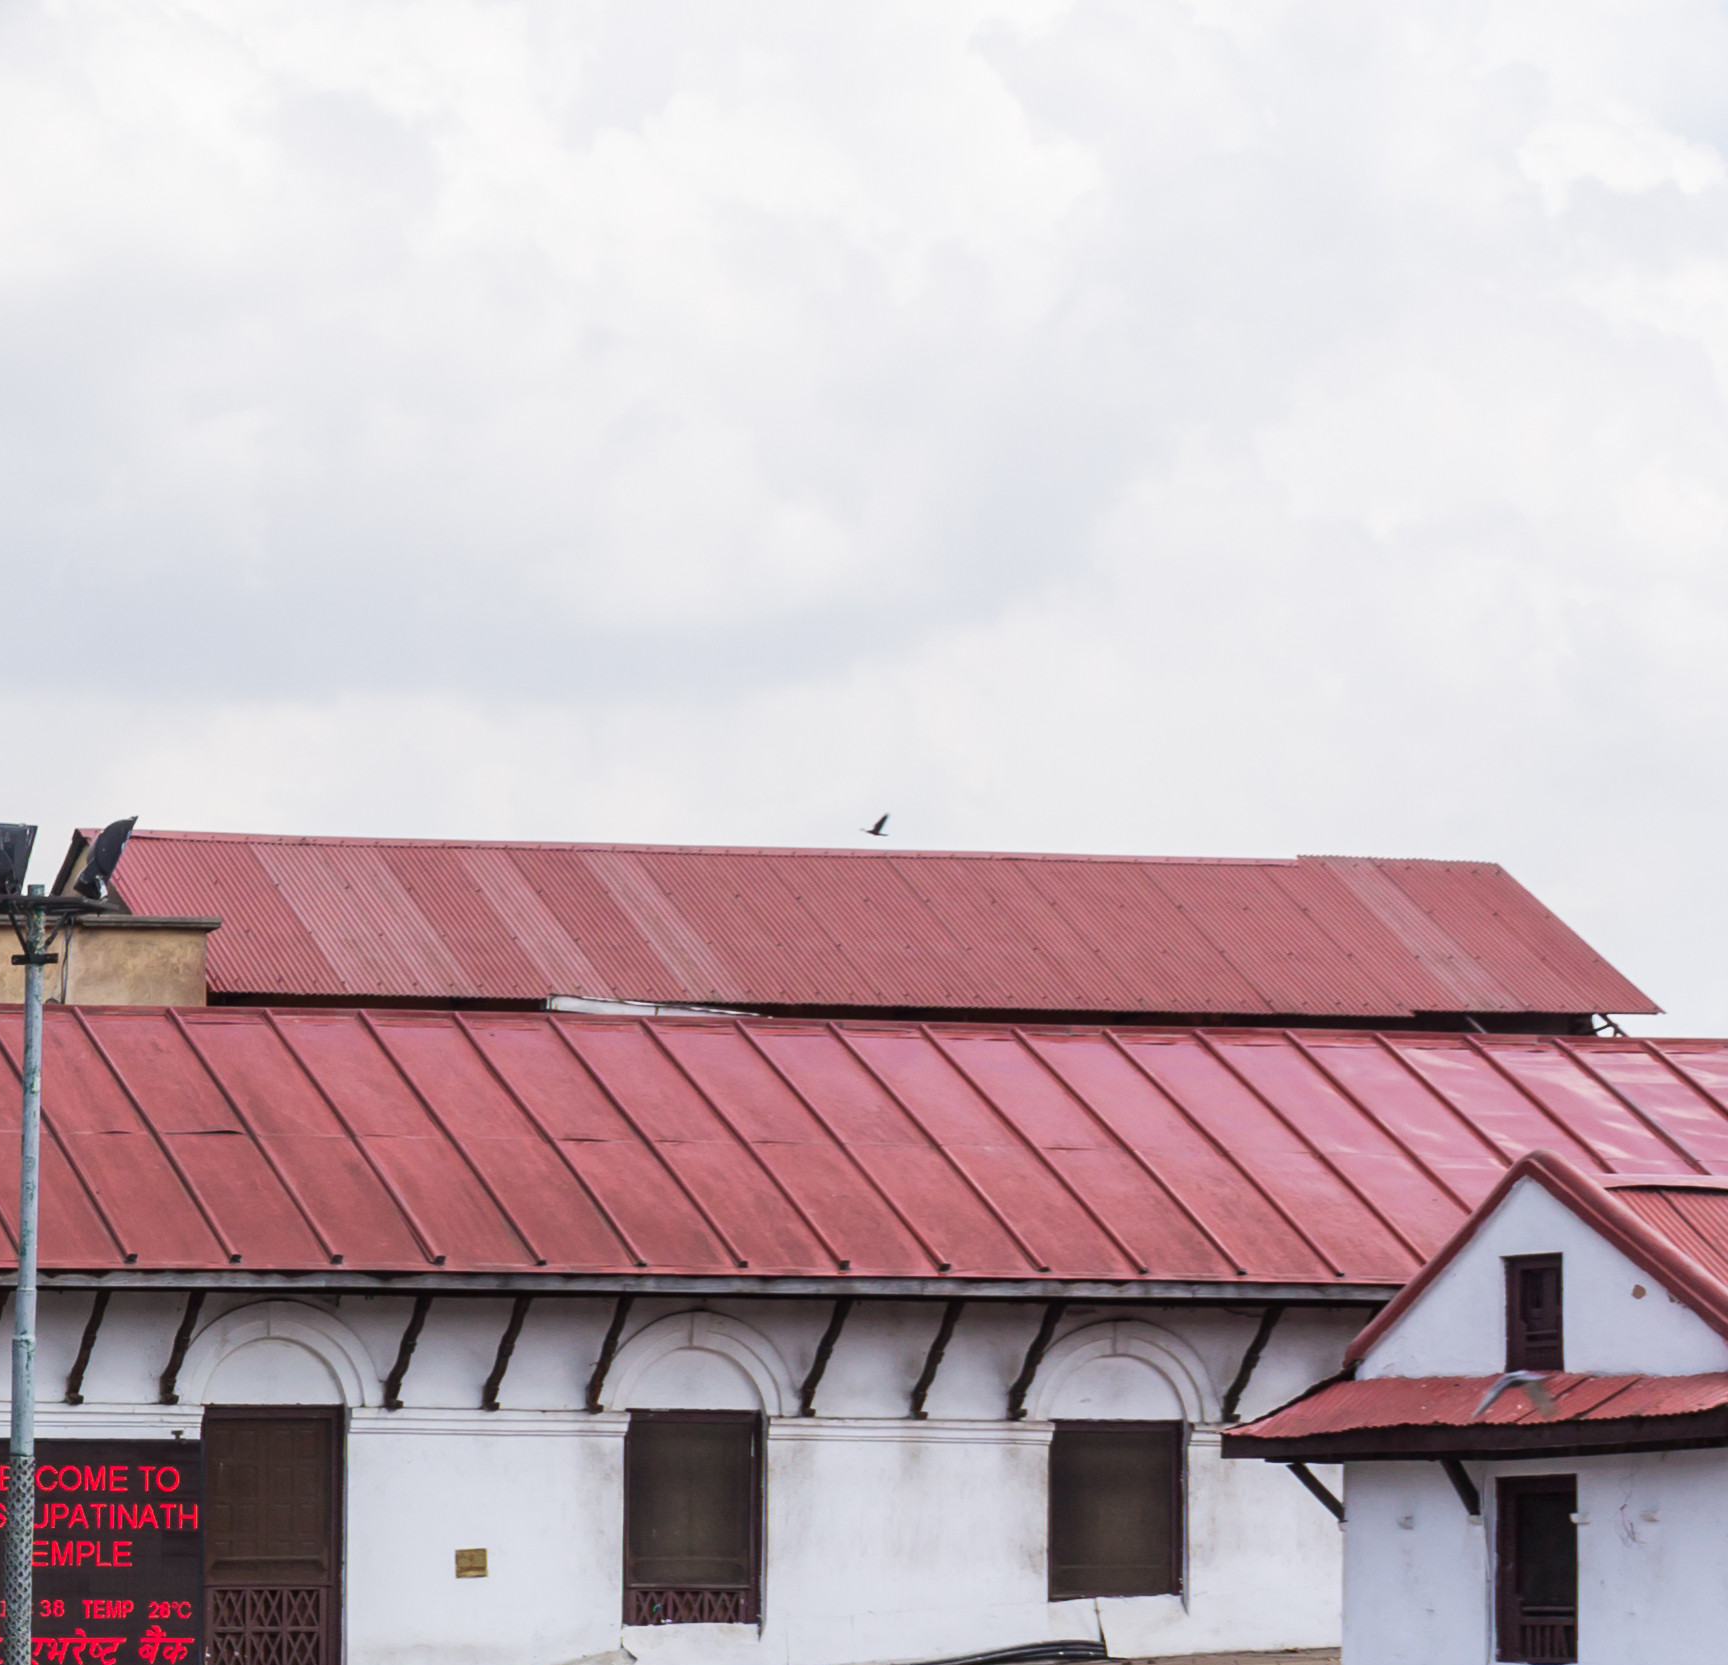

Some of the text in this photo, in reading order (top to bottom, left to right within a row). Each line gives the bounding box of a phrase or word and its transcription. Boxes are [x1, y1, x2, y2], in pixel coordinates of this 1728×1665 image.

[138, 1466, 181, 1492] TO
[32, 1541, 133, 1567] EMPLE
[81, 1599, 134, 1619] TEMP
[138, 1624, 195, 1665] बैंक
